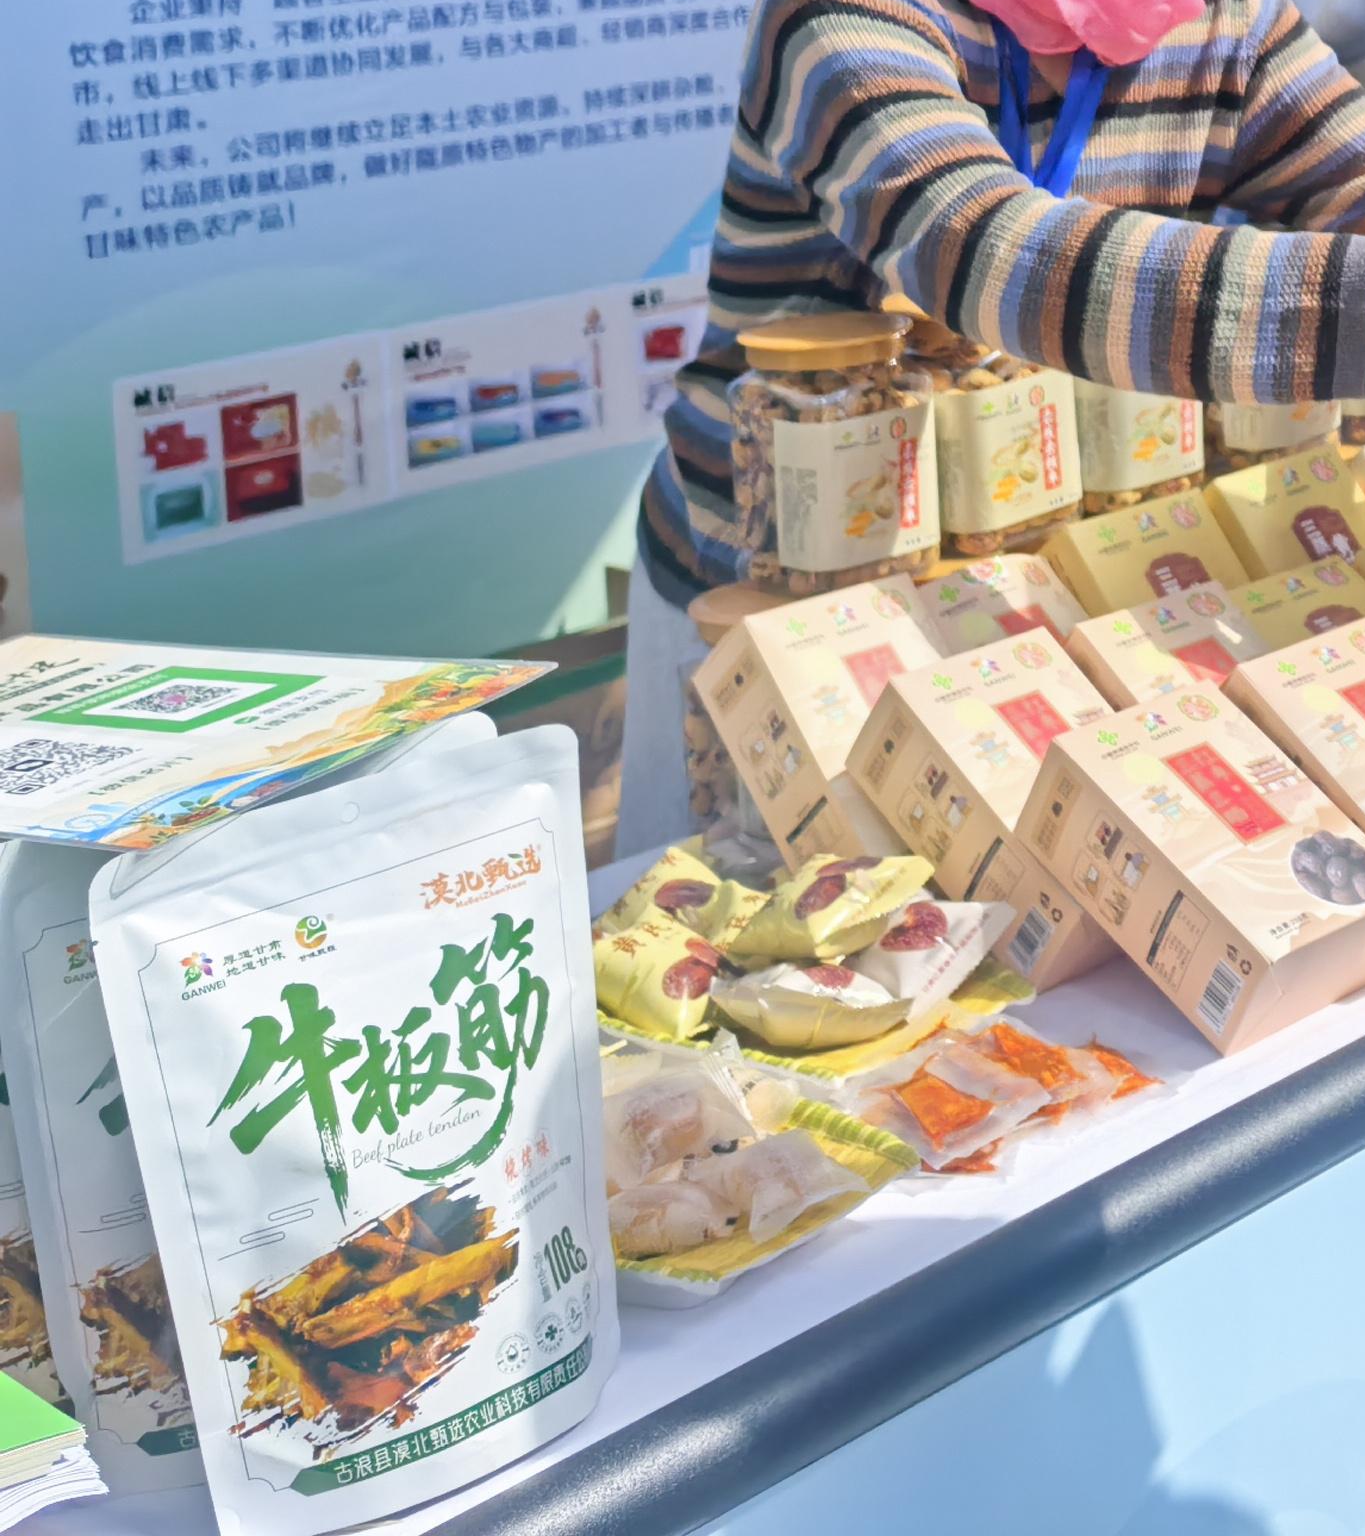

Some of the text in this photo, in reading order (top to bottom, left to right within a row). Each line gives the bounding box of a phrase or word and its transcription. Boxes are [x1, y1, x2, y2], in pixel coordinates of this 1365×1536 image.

[420, 844, 541, 910] 漠北甄选
[181, 978, 227, 1001] GANWEI
[206, 912, 550, 1226] 牛板筋
[351, 1107, 482, 1169] Beef plate tendon
